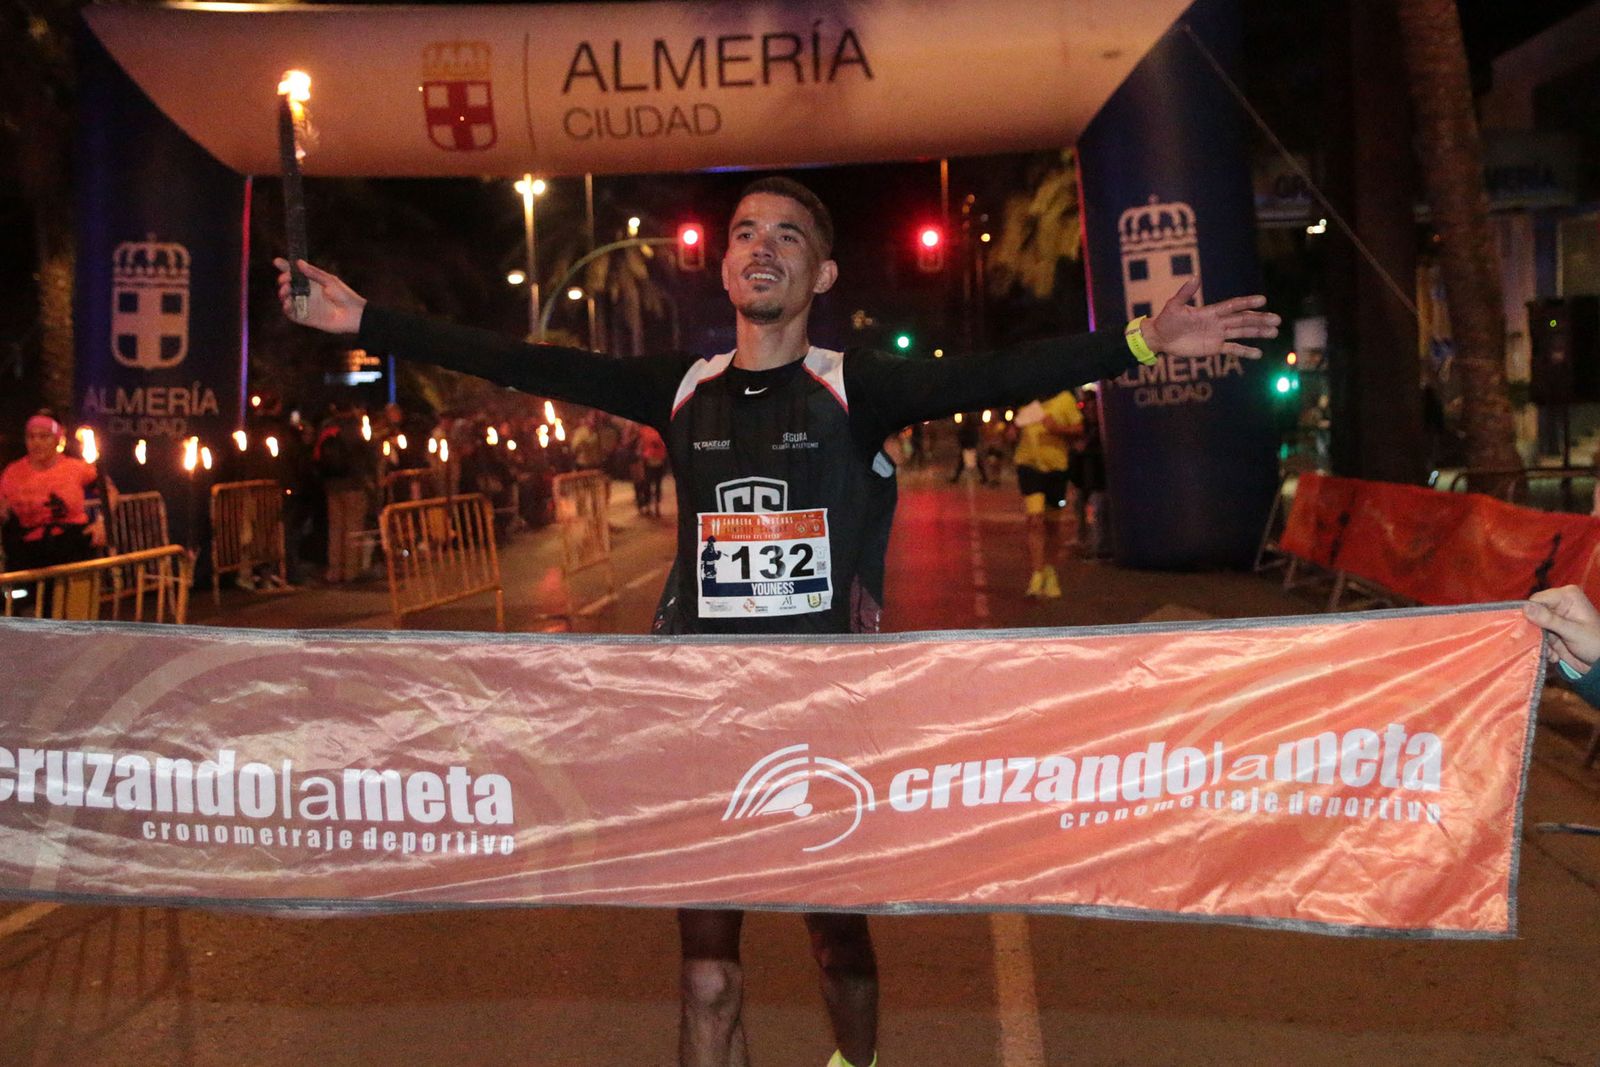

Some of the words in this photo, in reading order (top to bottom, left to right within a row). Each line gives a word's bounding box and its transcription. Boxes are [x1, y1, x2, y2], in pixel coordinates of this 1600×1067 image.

[561, 20, 875, 95] ALMERÍA
[562, 103, 723, 141] CIUDAD
[80, 379, 220, 417] ALMERÍA
[1133, 383, 1214, 408] CIUDAD
[731, 543, 815, 580] 132
[751, 581, 795, 595] YOUNESS
[888, 722, 1442, 813] cruzandolameta
[1059, 786, 1279, 830] cronometraje
[1288, 789, 1441, 825] deportivo
[142, 820, 353, 852] cronometraje
[363, 827, 515, 856] deportivo
